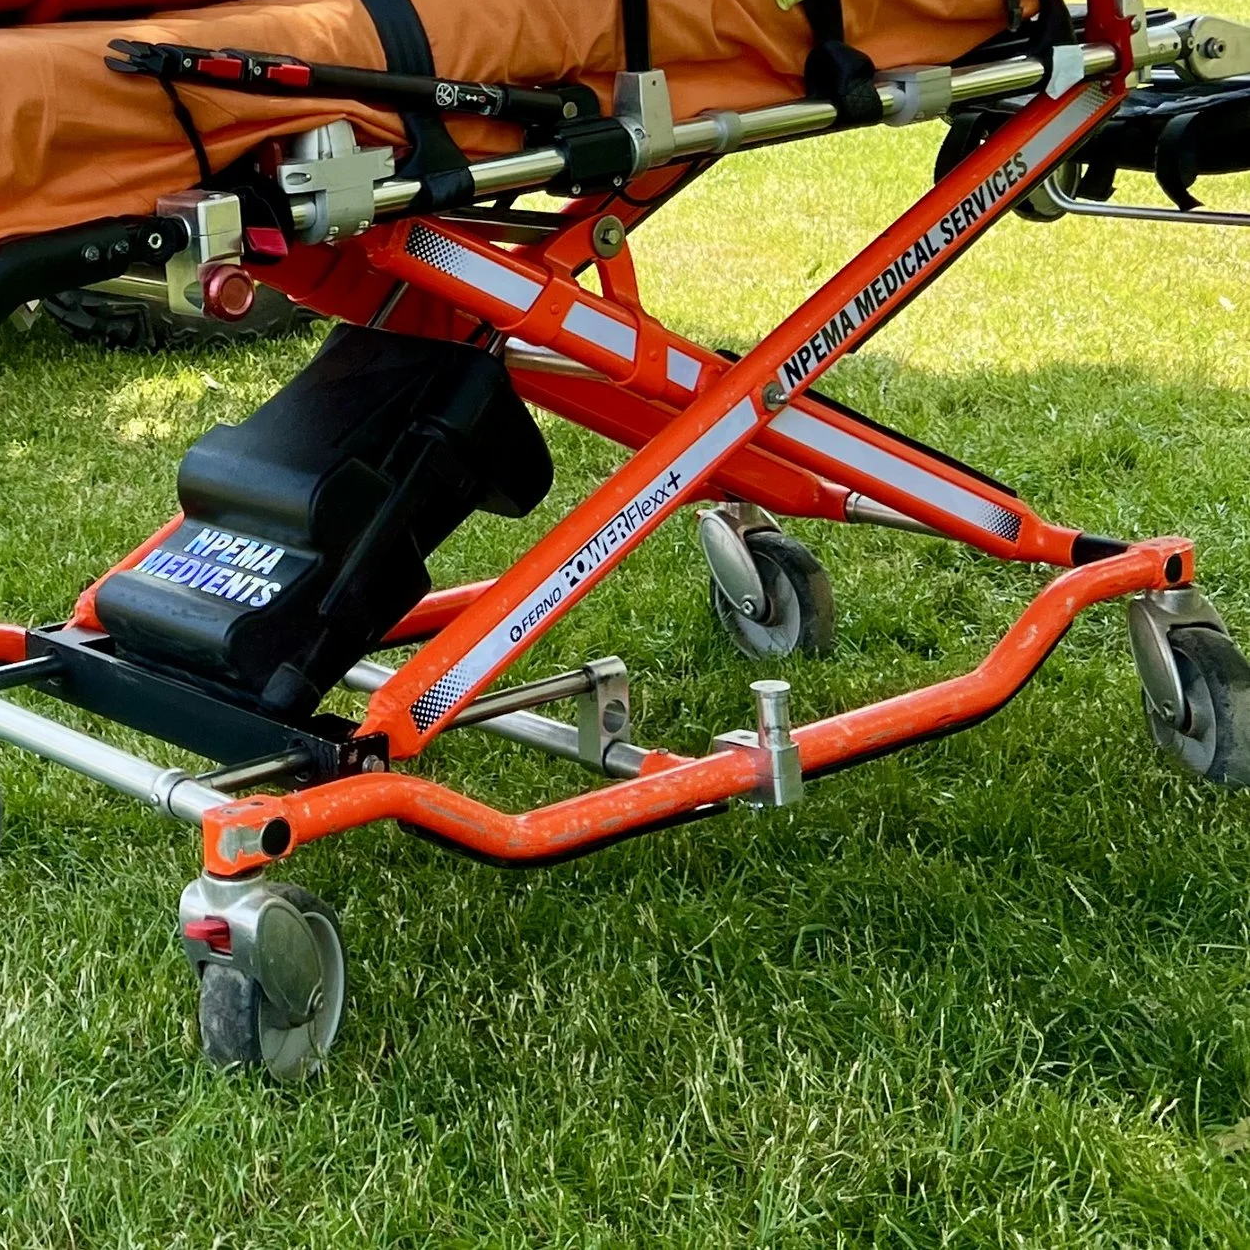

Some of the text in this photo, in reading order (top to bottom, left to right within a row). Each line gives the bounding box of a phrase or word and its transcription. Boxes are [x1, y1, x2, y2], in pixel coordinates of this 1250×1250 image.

[783, 151, 1028, 389] NPEMA MEDICAL SERVICES
[133, 548, 282, 608] MEDVENTS
[184, 527, 286, 576] NPEMA
[521, 586, 562, 633] FERNO
